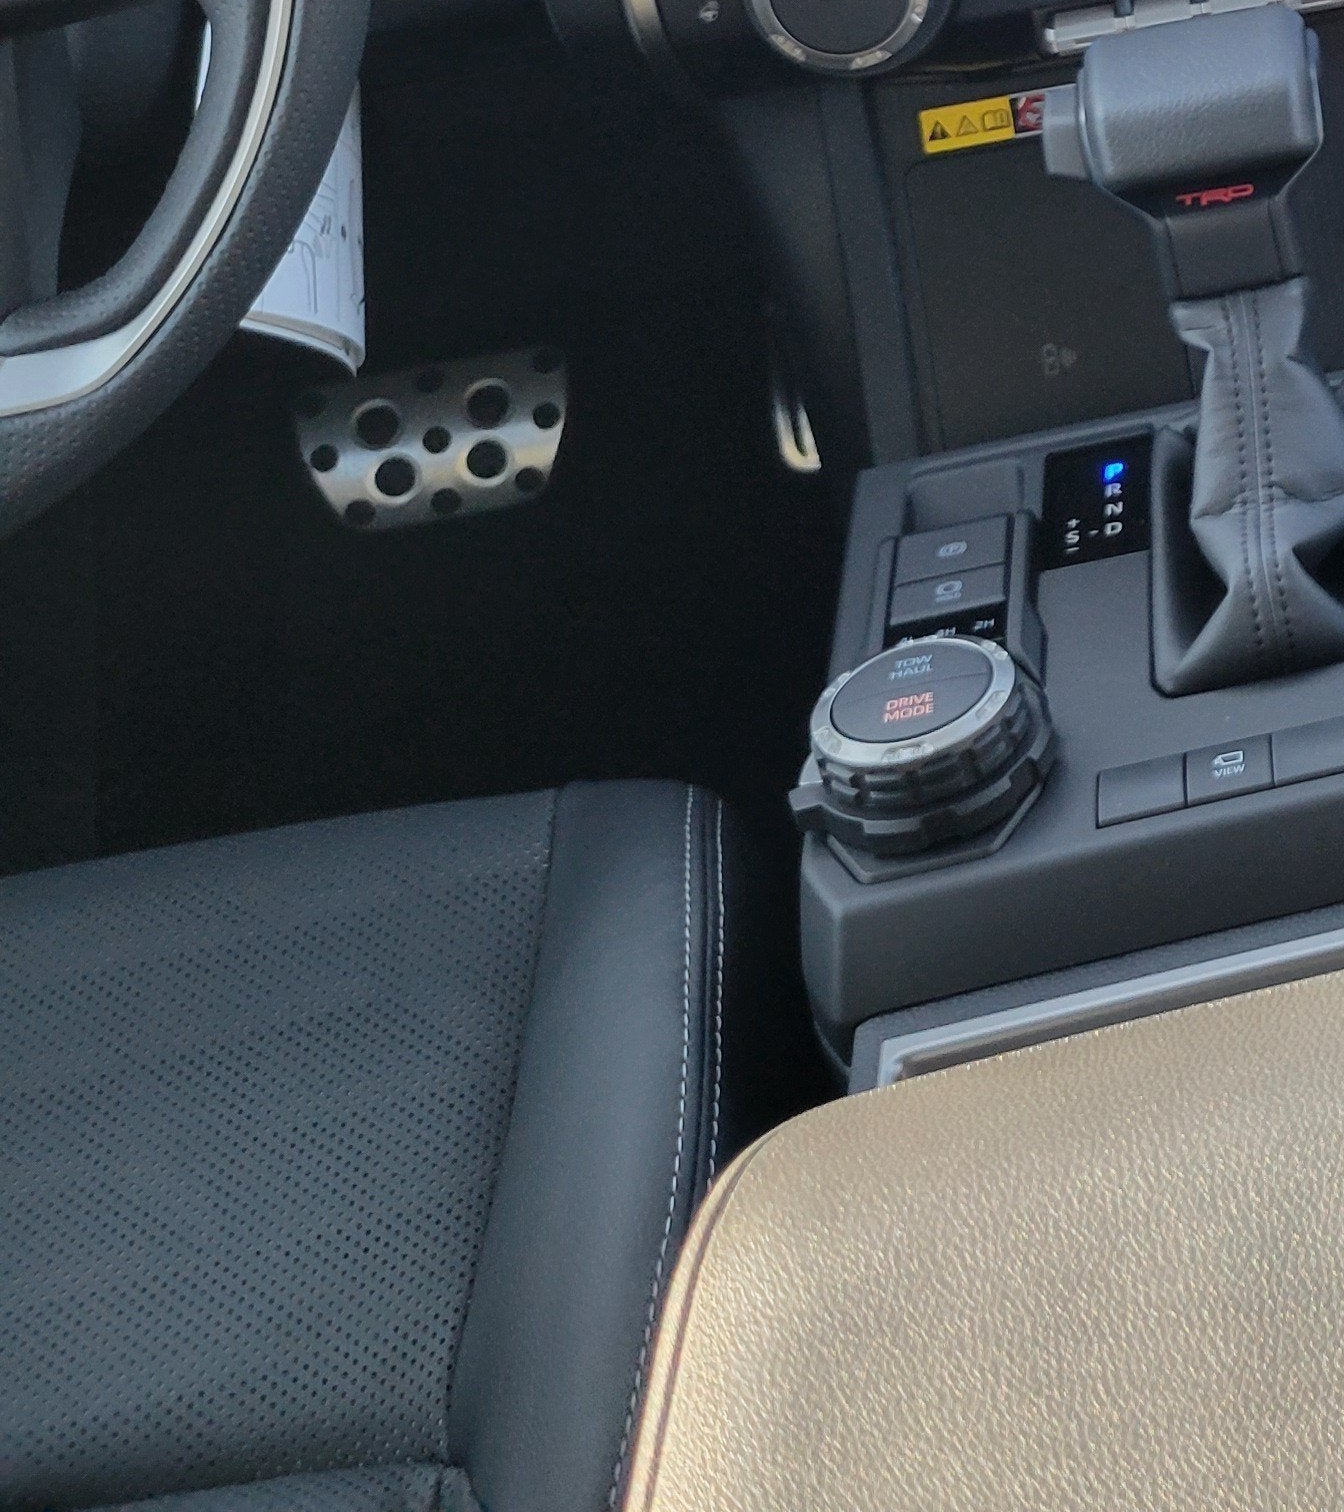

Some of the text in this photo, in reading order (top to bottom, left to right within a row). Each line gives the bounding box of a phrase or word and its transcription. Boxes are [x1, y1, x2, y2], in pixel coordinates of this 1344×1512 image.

[1175, 183, 1255, 207] TRD
[1104, 462, 1124, 480] P
[1104, 482, 1122, 498] R
[1104, 501, 1123, 516] N
[1104, 521, 1123, 537] D
[895, 654, 933, 669] TOW
[888, 664, 933, 680] HAUL
[886, 691, 934, 711] DRIVE
[884, 703, 934, 724] MODE
[1214, 763, 1245, 778] VIEW
